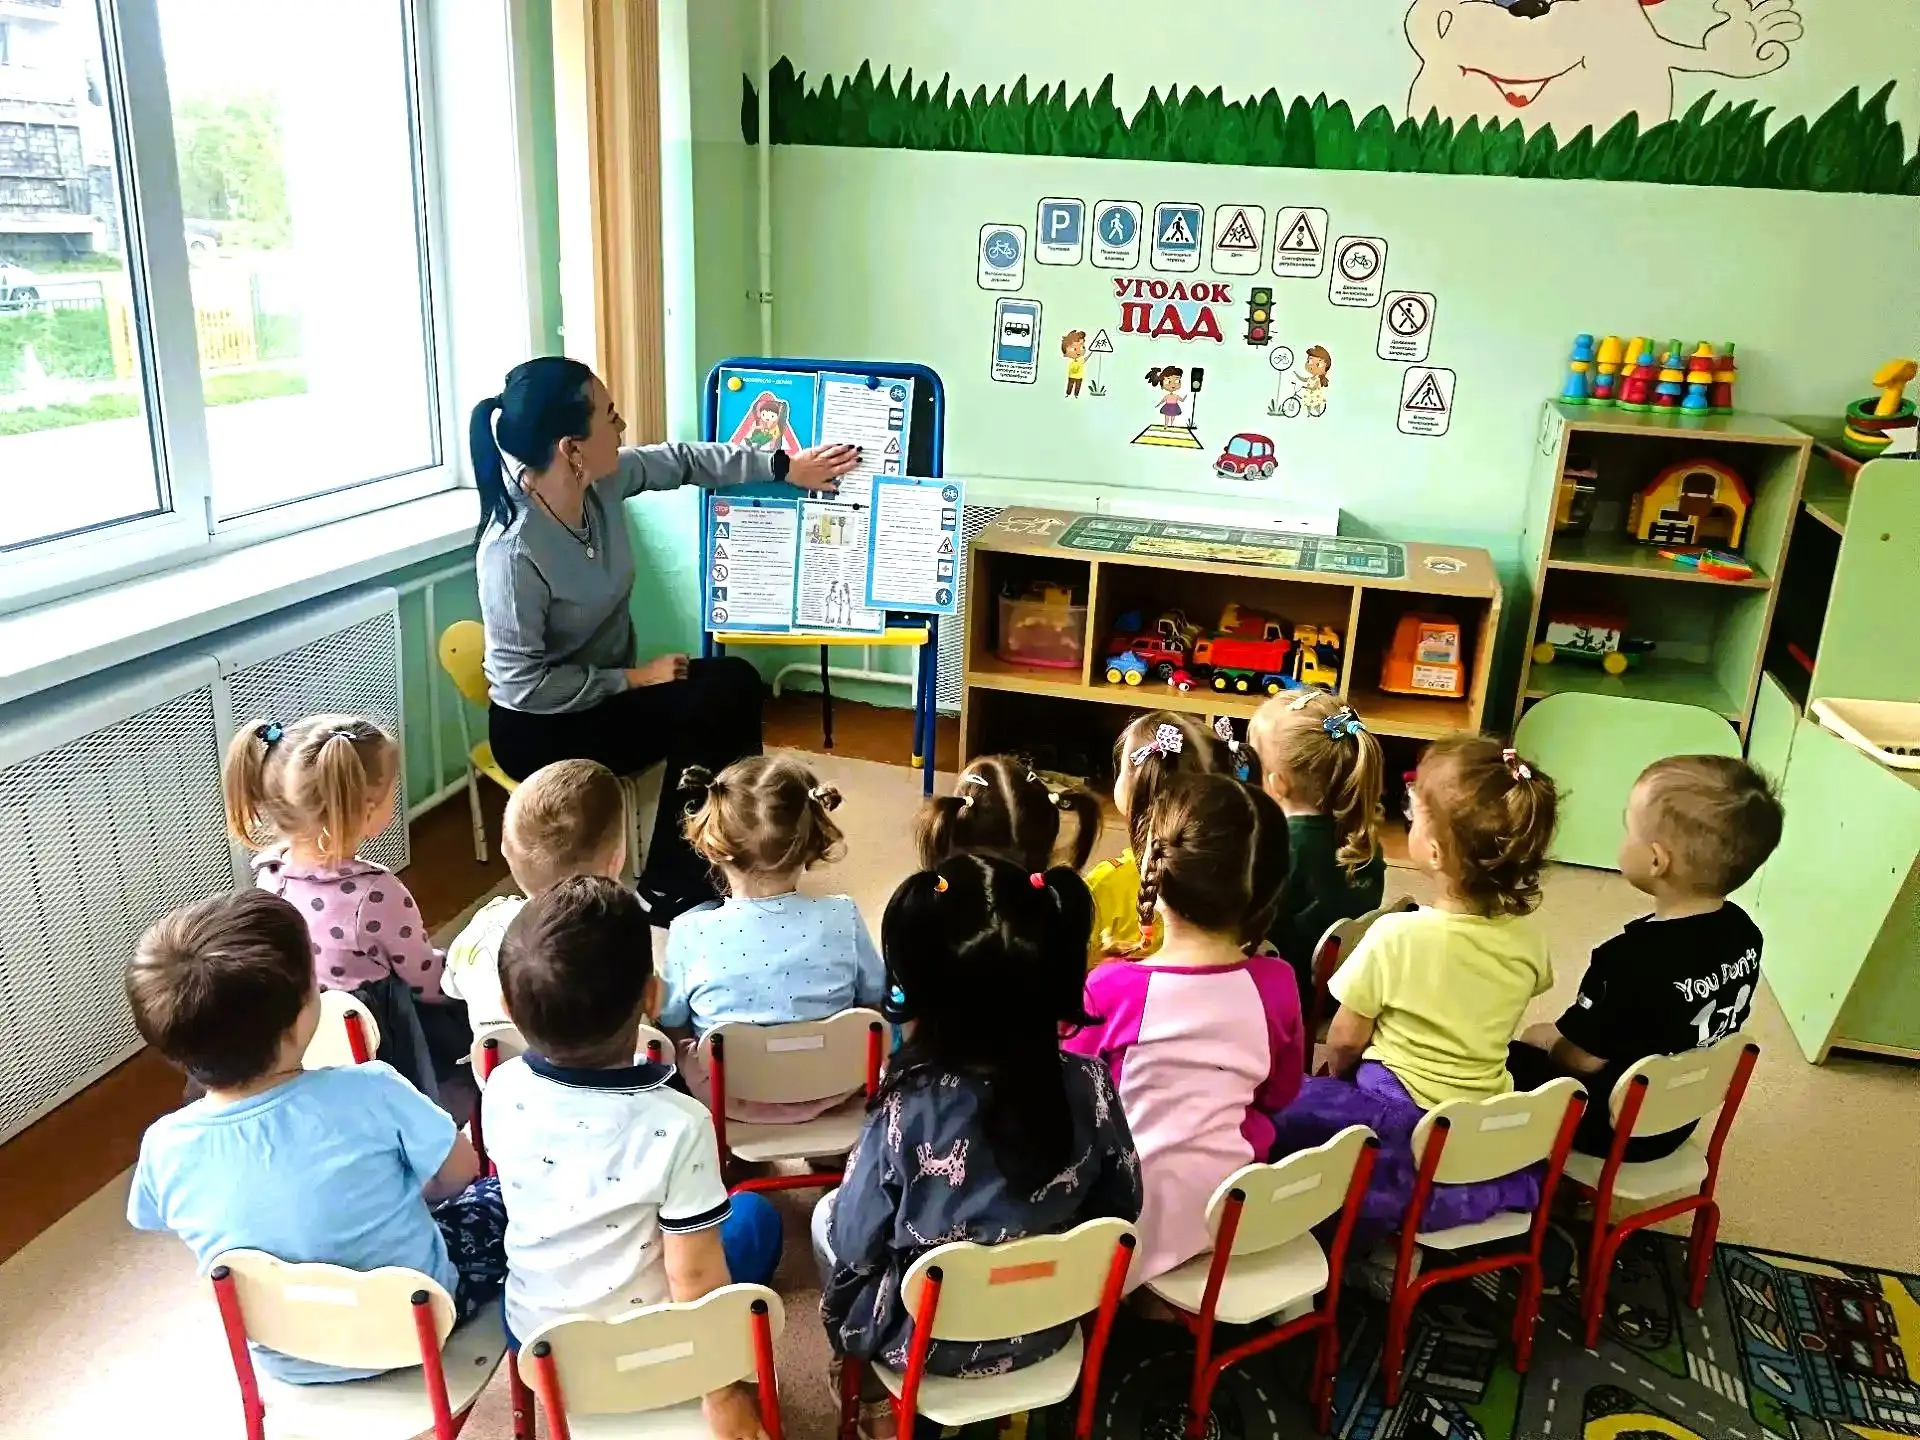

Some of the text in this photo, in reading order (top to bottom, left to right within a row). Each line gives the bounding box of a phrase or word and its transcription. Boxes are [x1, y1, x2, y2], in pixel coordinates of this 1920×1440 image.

[1051, 209, 1071, 239] P
[1113, 276, 1232, 304] УГОЛОК
[1118, 301, 1224, 343] ПДД
[714, 506, 729, 514] STOP
